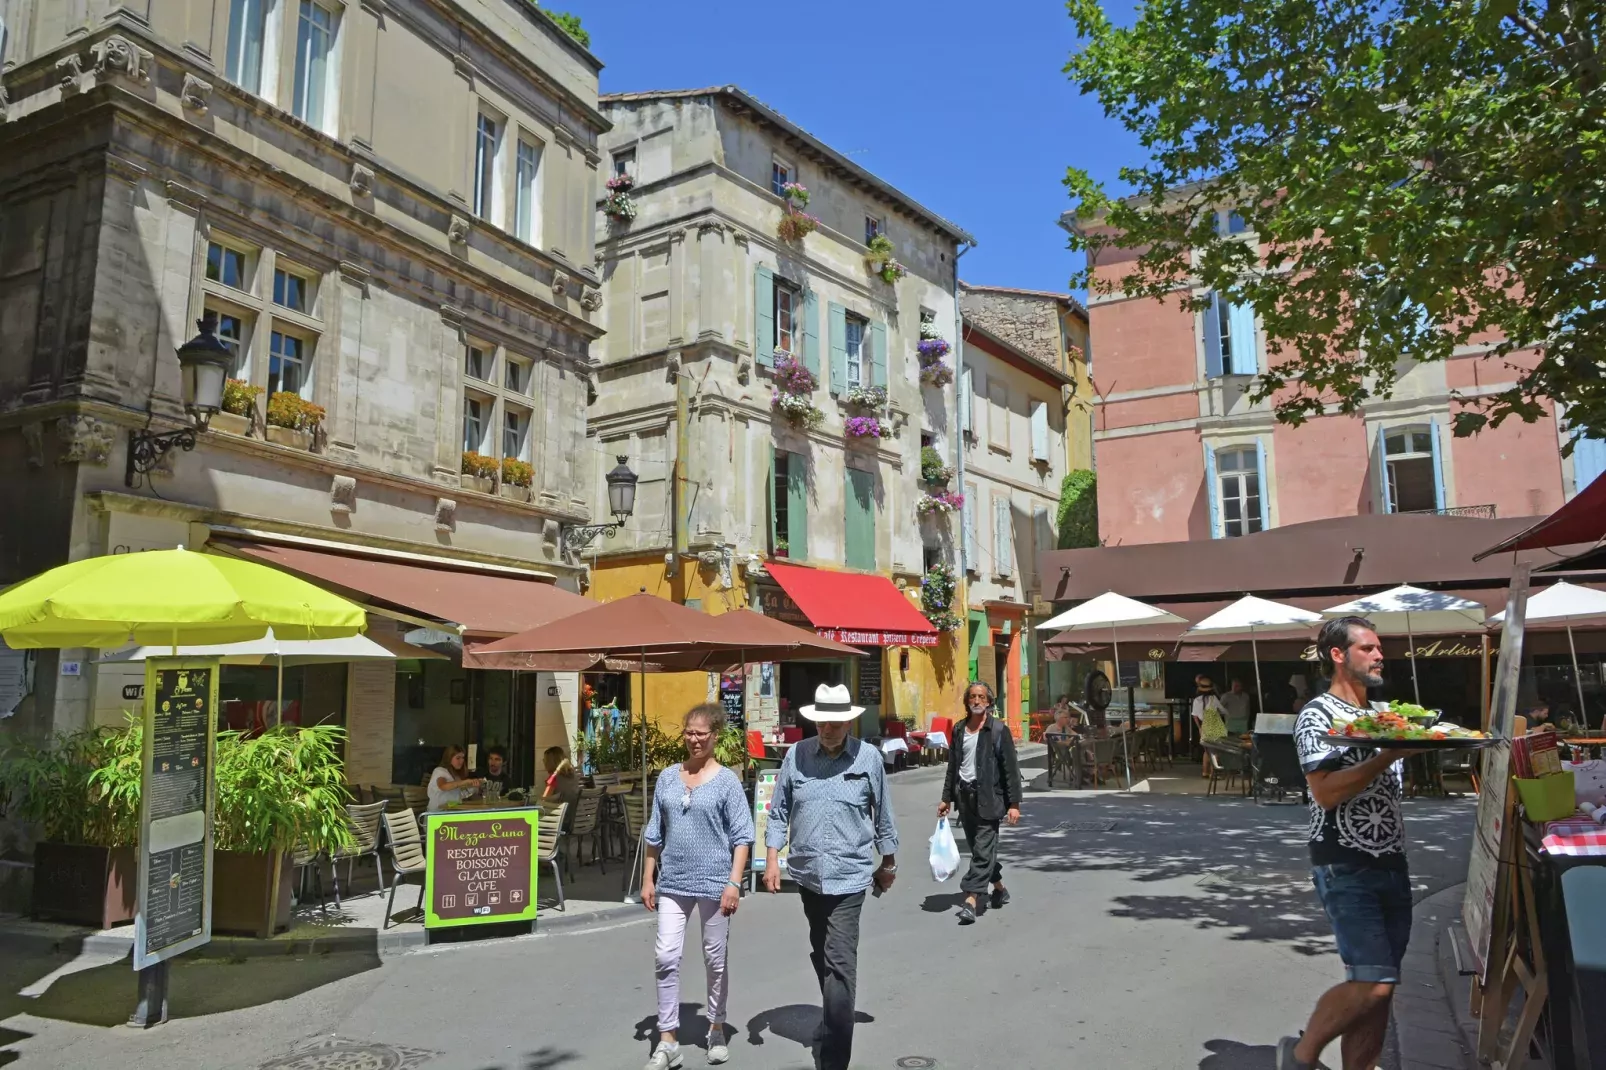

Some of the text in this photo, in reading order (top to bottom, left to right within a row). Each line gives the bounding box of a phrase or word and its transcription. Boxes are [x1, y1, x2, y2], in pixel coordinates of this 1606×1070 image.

[840, 629, 879, 644] Restaurant
[440, 823, 526, 846] Mezza Luna
[447, 845, 519, 859] RESTAURANT
[456, 857, 509, 870] BOISSONS
[458, 869, 506, 881] GLACIER
[467, 881, 497, 892] CAFE
